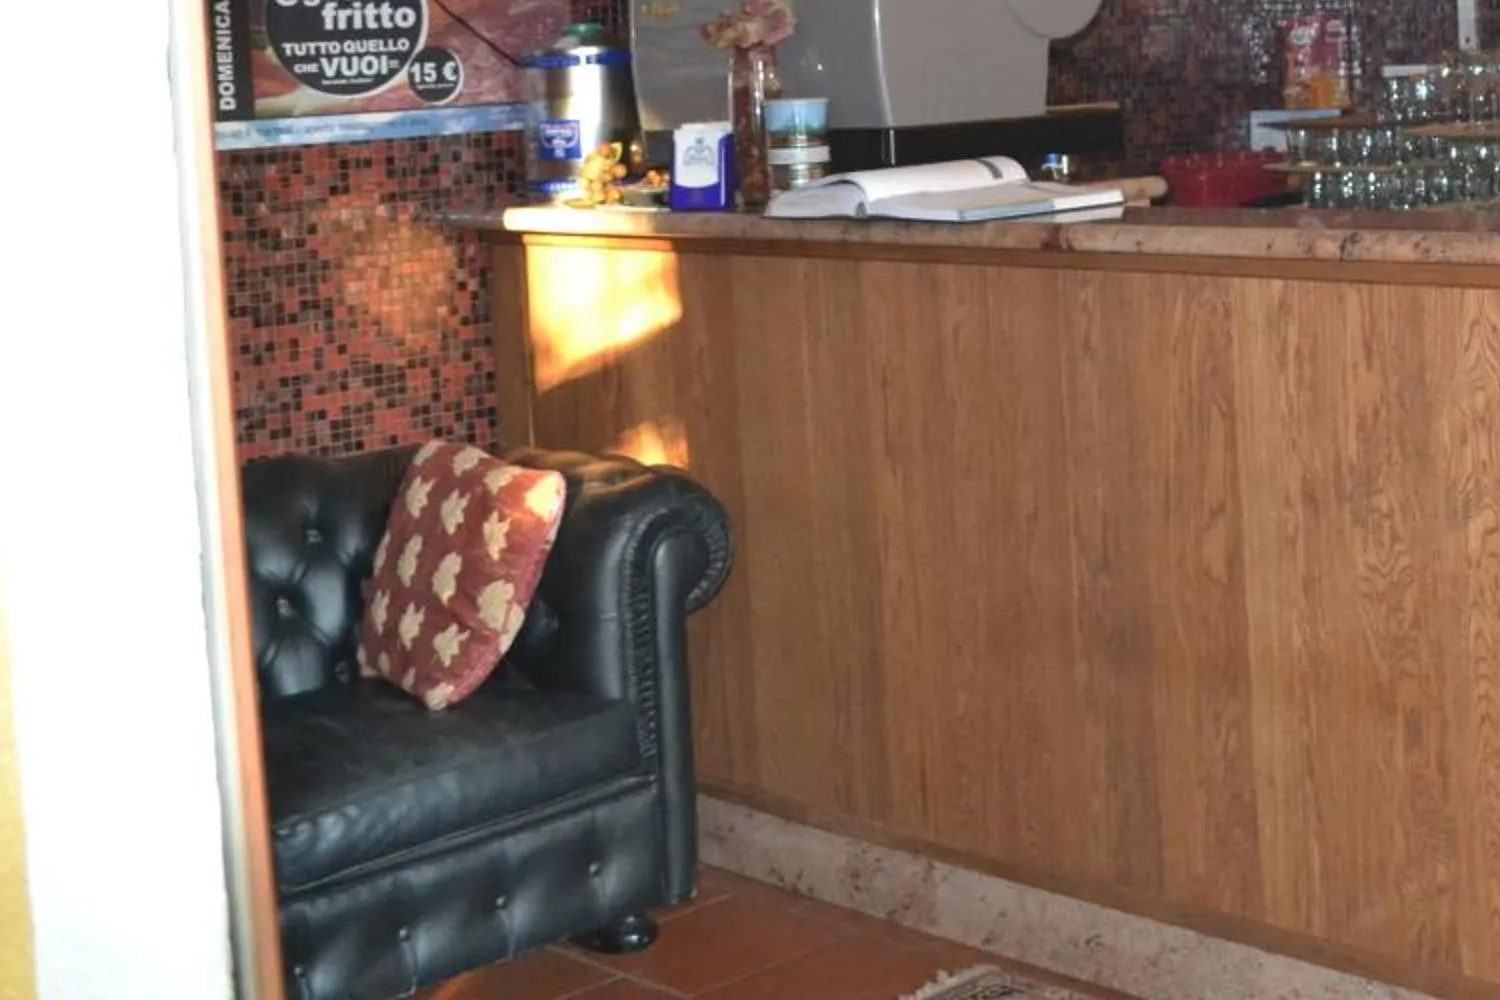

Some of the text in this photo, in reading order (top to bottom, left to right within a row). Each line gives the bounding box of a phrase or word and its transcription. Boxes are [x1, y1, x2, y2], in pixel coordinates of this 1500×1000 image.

[322, 2, 416, 30] fritto
[215, 0, 237, 111] DOMENICA
[281, 37, 410, 57] TUTTO QUELLO
[294, 63, 319, 73] CHE
[410, 62, 437, 83] 15
